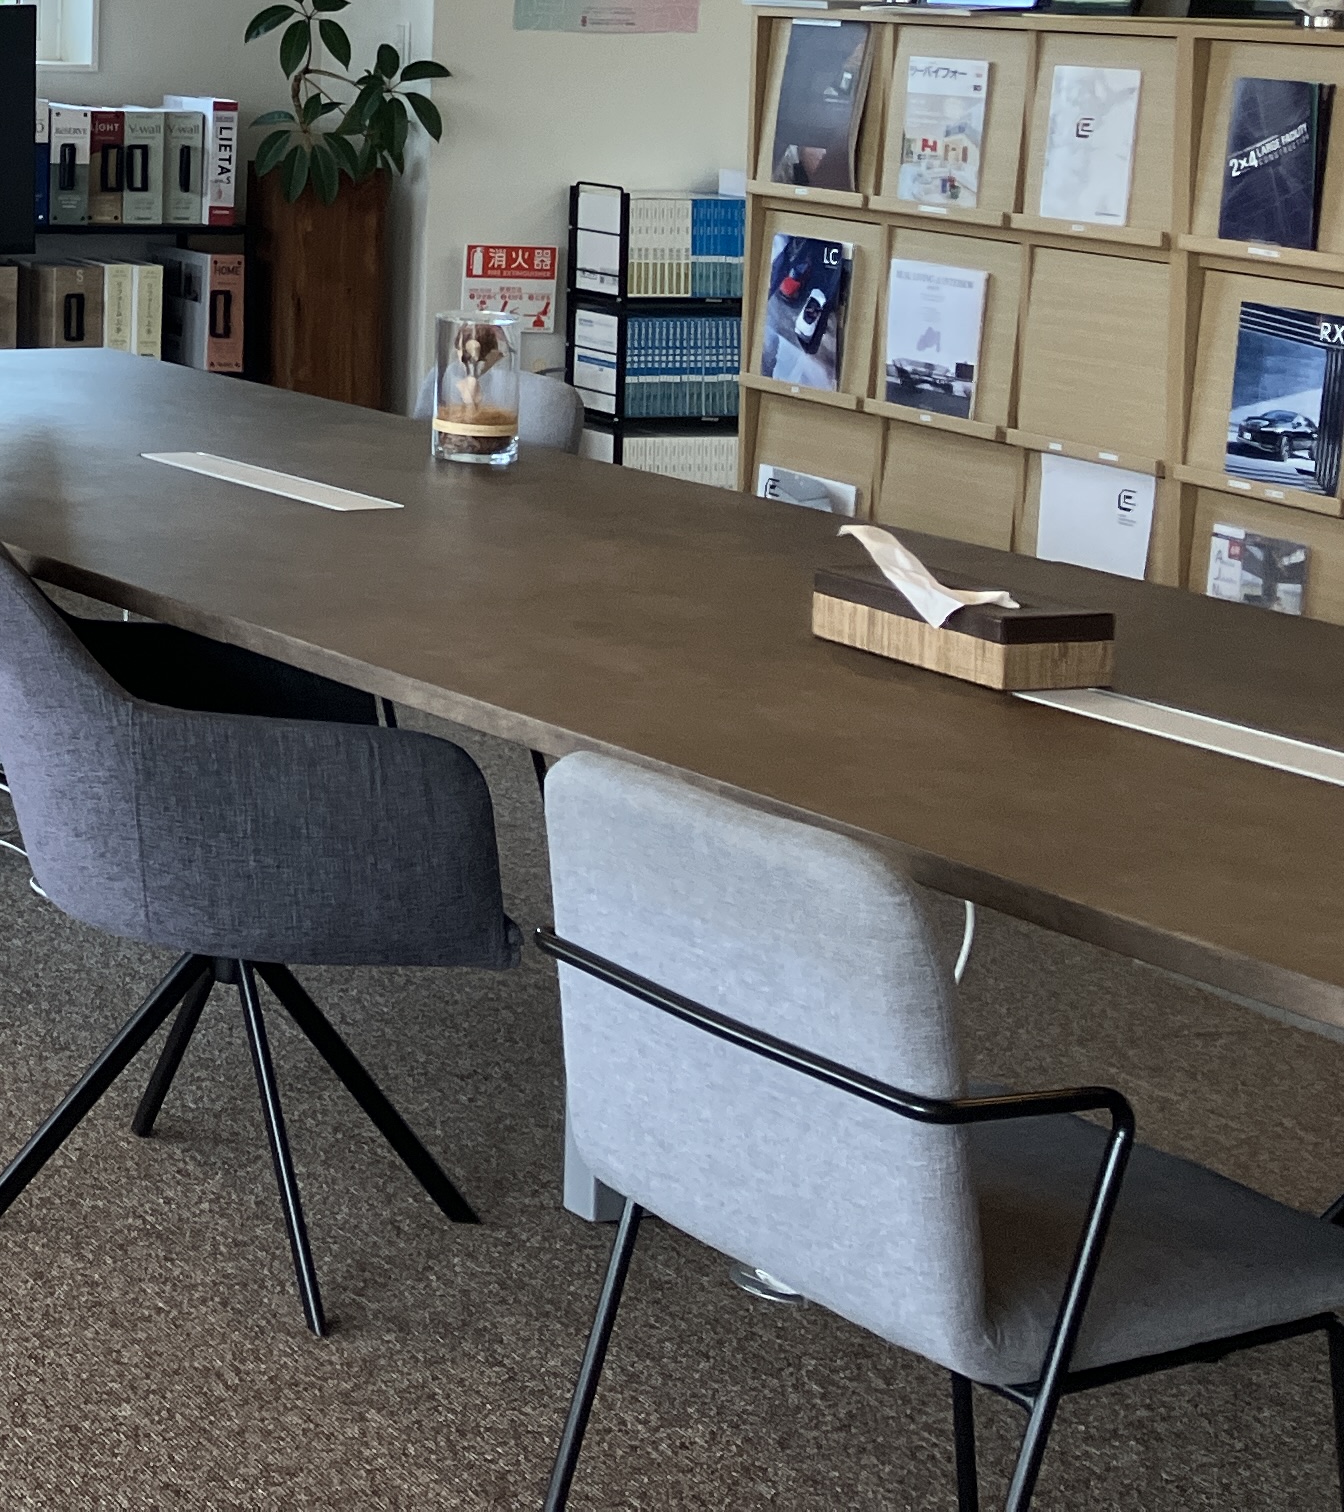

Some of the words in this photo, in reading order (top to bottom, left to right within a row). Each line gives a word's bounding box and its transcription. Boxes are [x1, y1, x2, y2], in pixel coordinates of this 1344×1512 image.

[488, 248, 552, 270] 消火器
[823, 247, 839, 265] LC
[1319, 322, 1344, 345] RX
